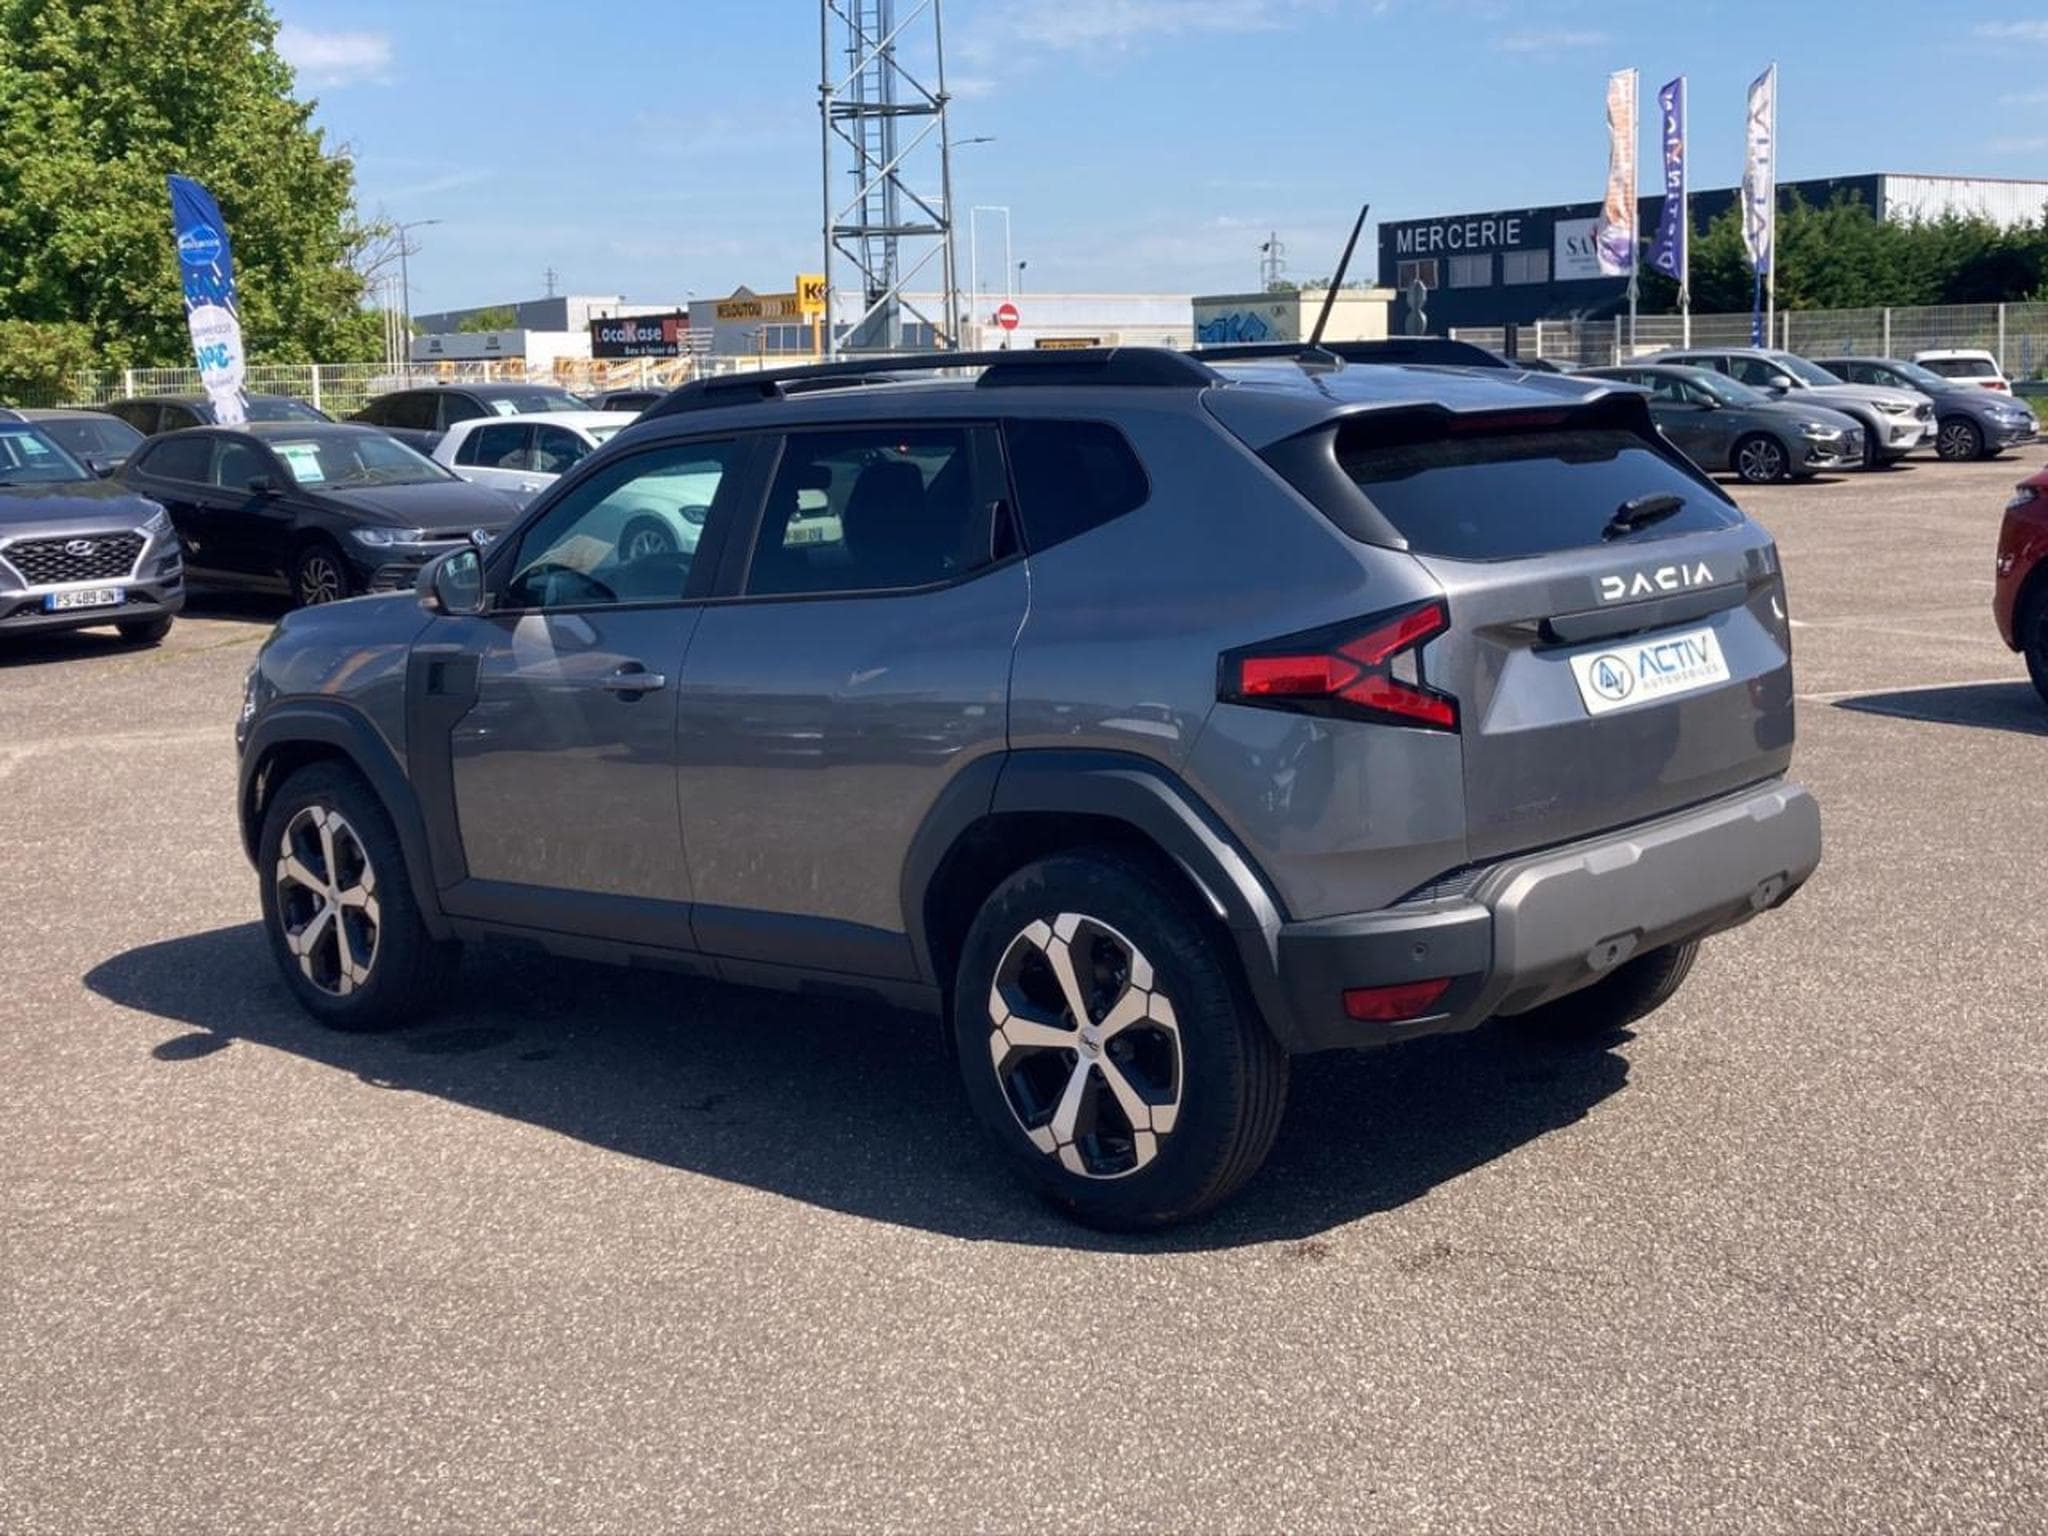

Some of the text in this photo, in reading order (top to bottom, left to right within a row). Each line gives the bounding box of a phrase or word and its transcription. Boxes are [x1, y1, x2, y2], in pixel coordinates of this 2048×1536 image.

[1397, 219, 1521, 254] MERCERIE
[594, 320, 662, 343] LocaKase
[1600, 562, 1713, 600] DACIA
[1639, 636, 1707, 679] ACTIV
